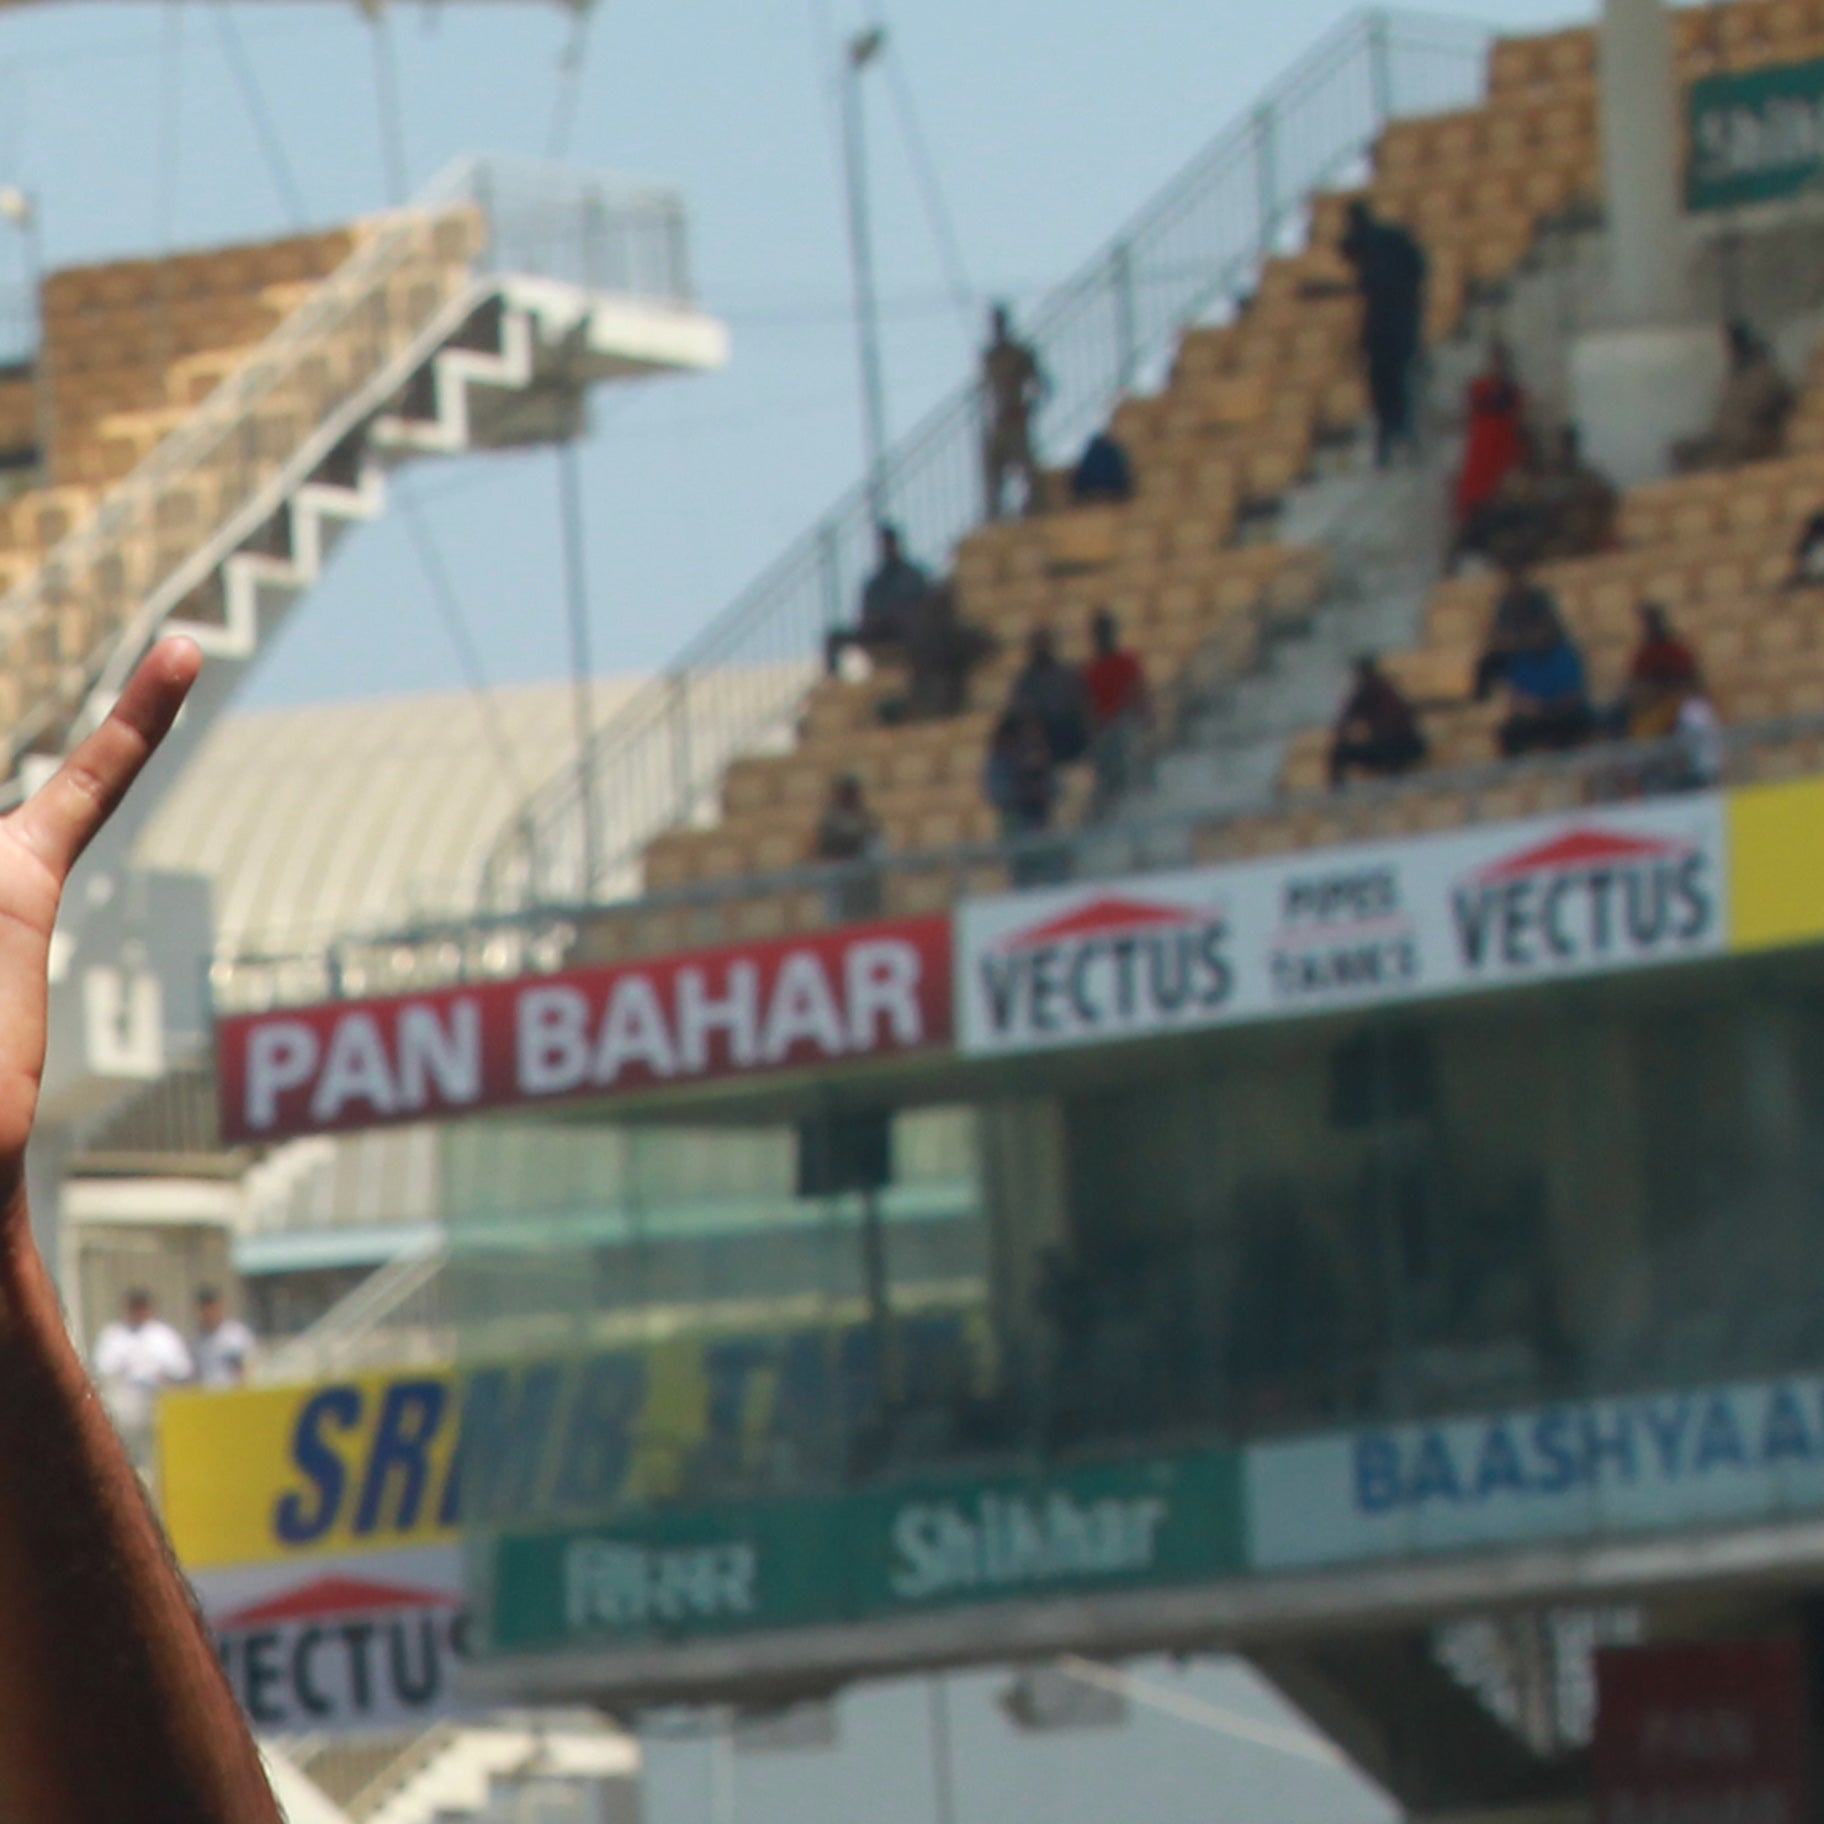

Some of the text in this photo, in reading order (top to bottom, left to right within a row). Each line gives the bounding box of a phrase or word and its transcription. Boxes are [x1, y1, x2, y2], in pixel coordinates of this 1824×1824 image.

[1451, 849, 1713, 971] VECTUS
[244, 936, 925, 1130] PAN BAHAR
[979, 921, 1234, 1034] VECTUS
[1355, 1386, 1824, 1513] BAASHYAA
